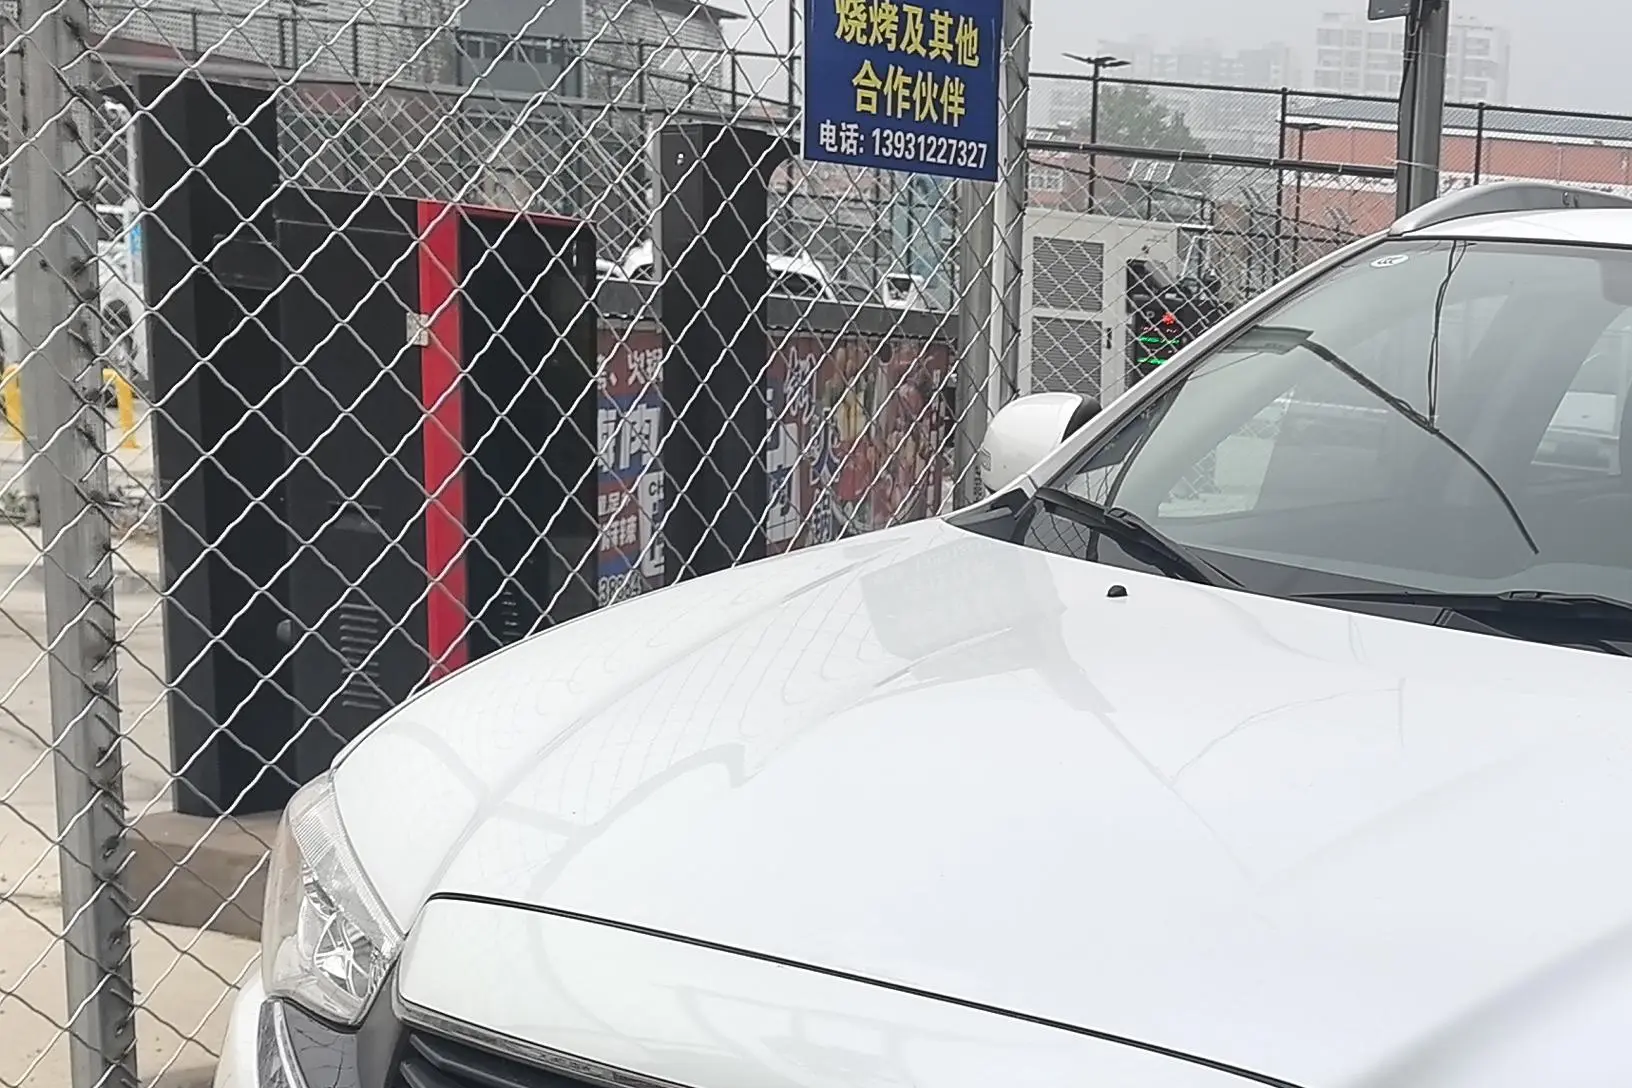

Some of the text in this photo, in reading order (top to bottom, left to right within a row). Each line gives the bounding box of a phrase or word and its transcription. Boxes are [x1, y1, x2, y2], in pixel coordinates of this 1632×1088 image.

[835, 0, 980, 65] 烧烤及其他
[851, 59, 966, 128] 合作伙伴
[871, 127, 988, 169] 13931227327
